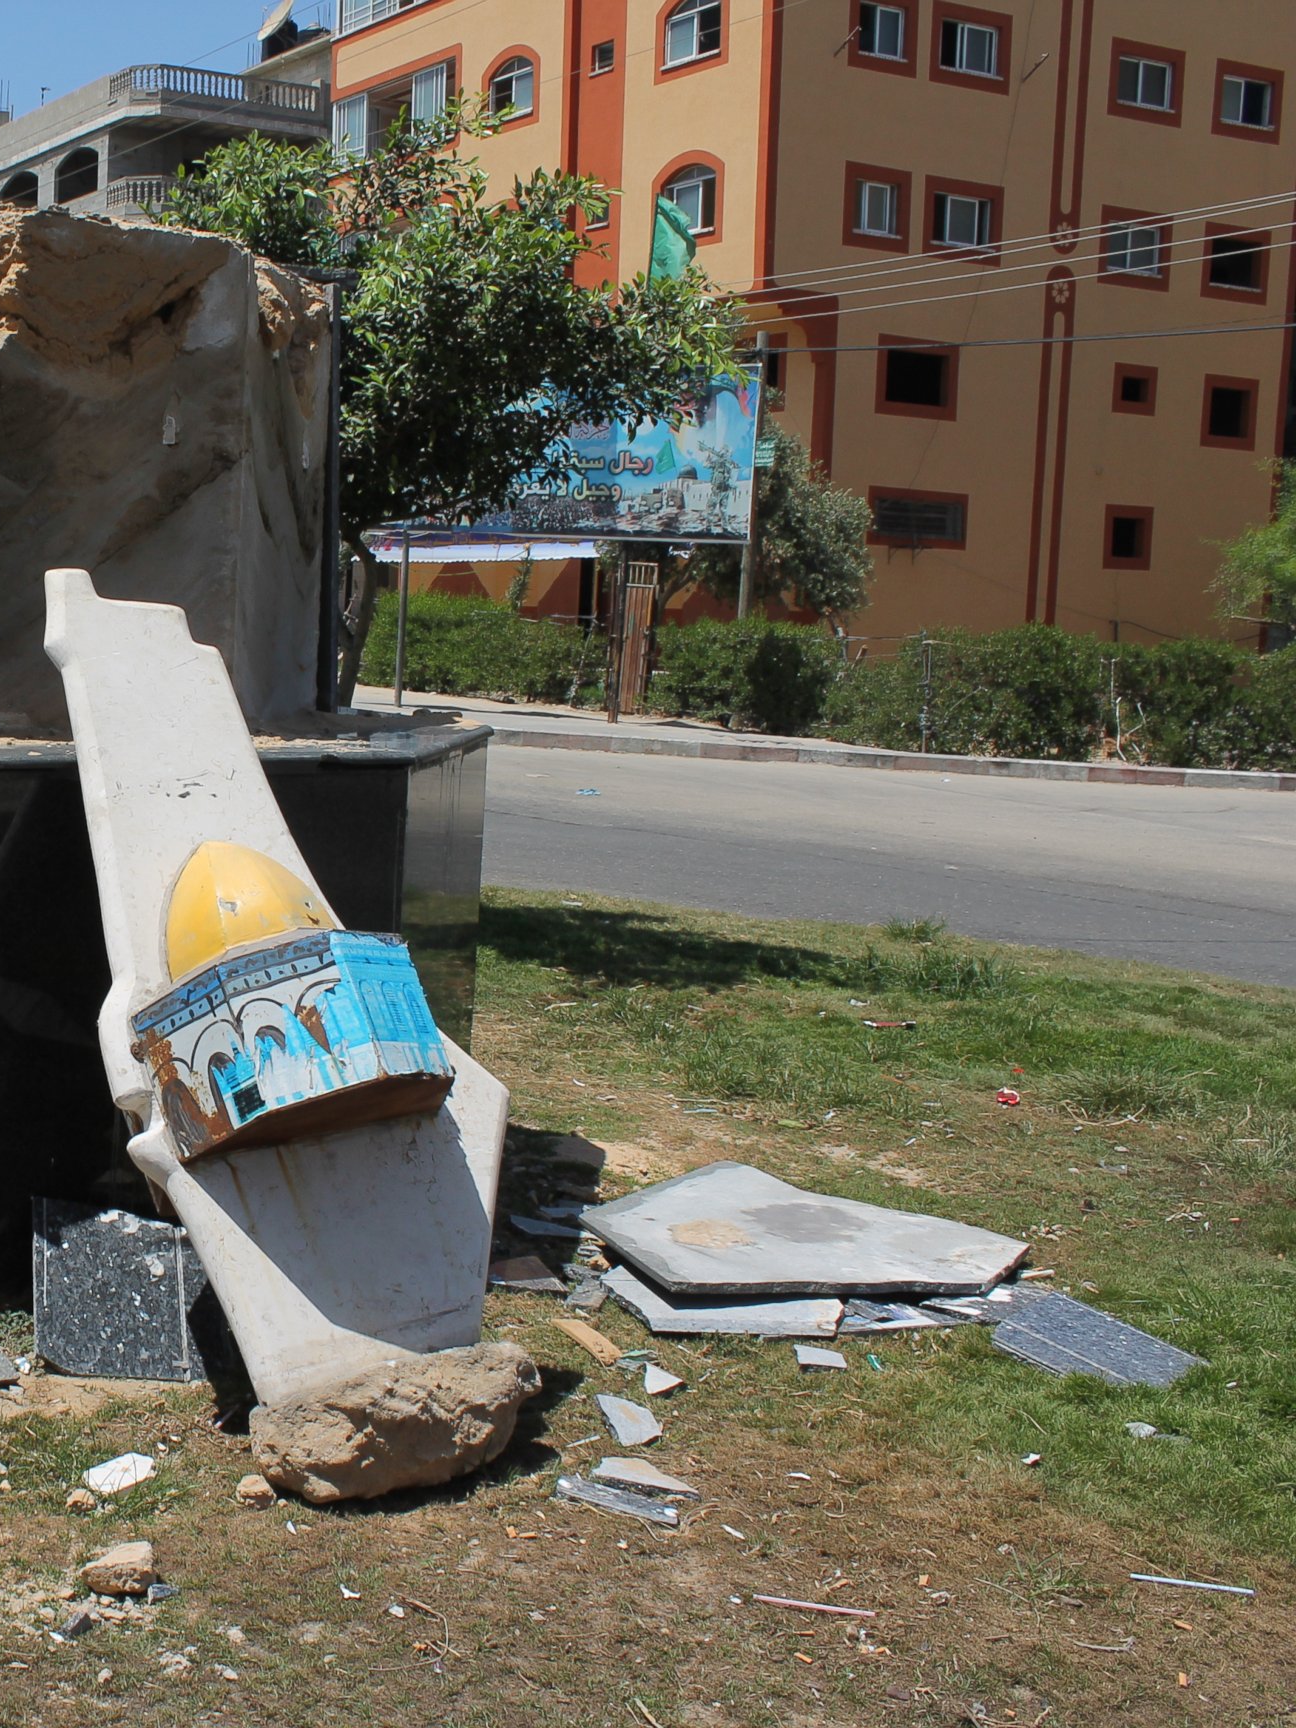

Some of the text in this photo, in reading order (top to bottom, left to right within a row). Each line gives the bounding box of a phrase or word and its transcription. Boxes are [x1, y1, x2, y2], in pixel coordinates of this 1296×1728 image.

[609, 450, 654, 476] رجال
[556, 477, 569, 497] لا
[572, 477, 622, 504] وجيل
